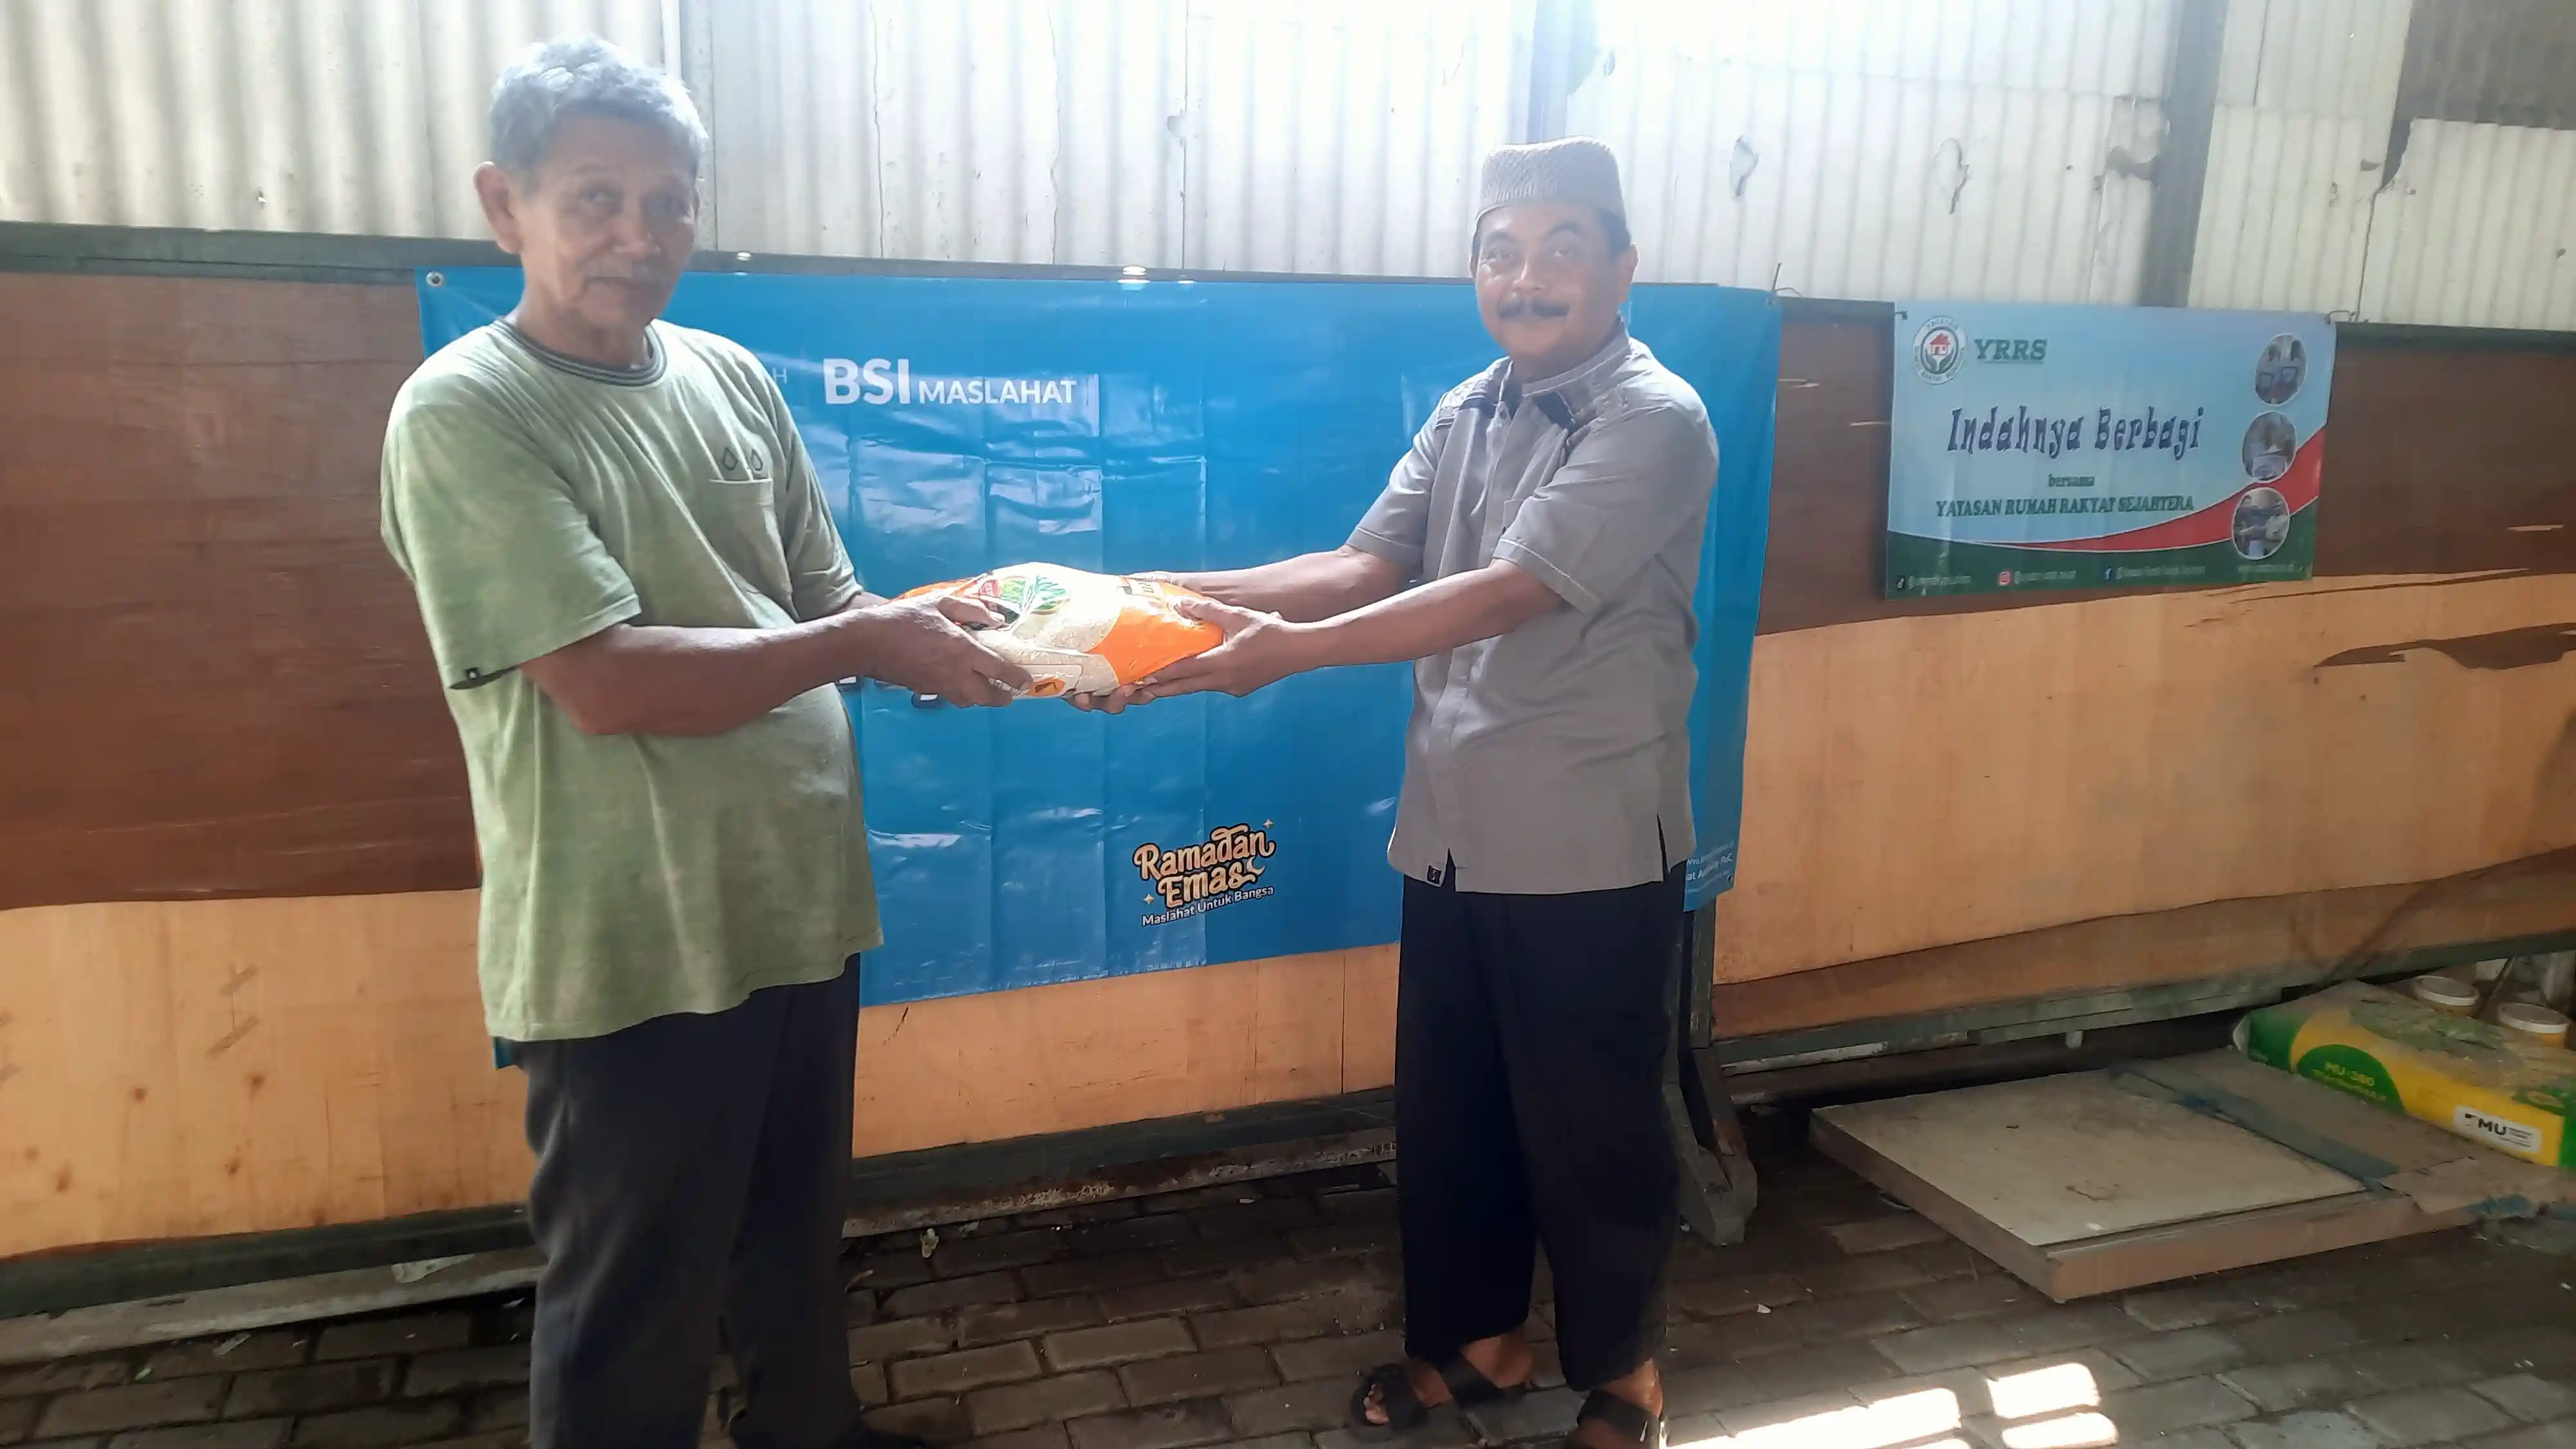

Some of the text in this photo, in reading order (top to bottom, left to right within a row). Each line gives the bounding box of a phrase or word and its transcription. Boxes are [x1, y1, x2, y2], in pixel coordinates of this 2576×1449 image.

[1975, 338, 2047, 361] YRRS
[822, 358, 1077, 405] BSI MASLAHAT
[1947, 404, 2204, 460] Indahnya Berbagi
[2048, 473, 2096, 488] bersama
[1936, 495, 2195, 517] YAYASAN RUMAH RAKYAT SEJAHTERA
[1132, 824, 1276, 880] Ramadan
[1142, 886, 1274, 927] Maslahat Untuk Bangsa
[1157, 862, 1256, 908] Emas
